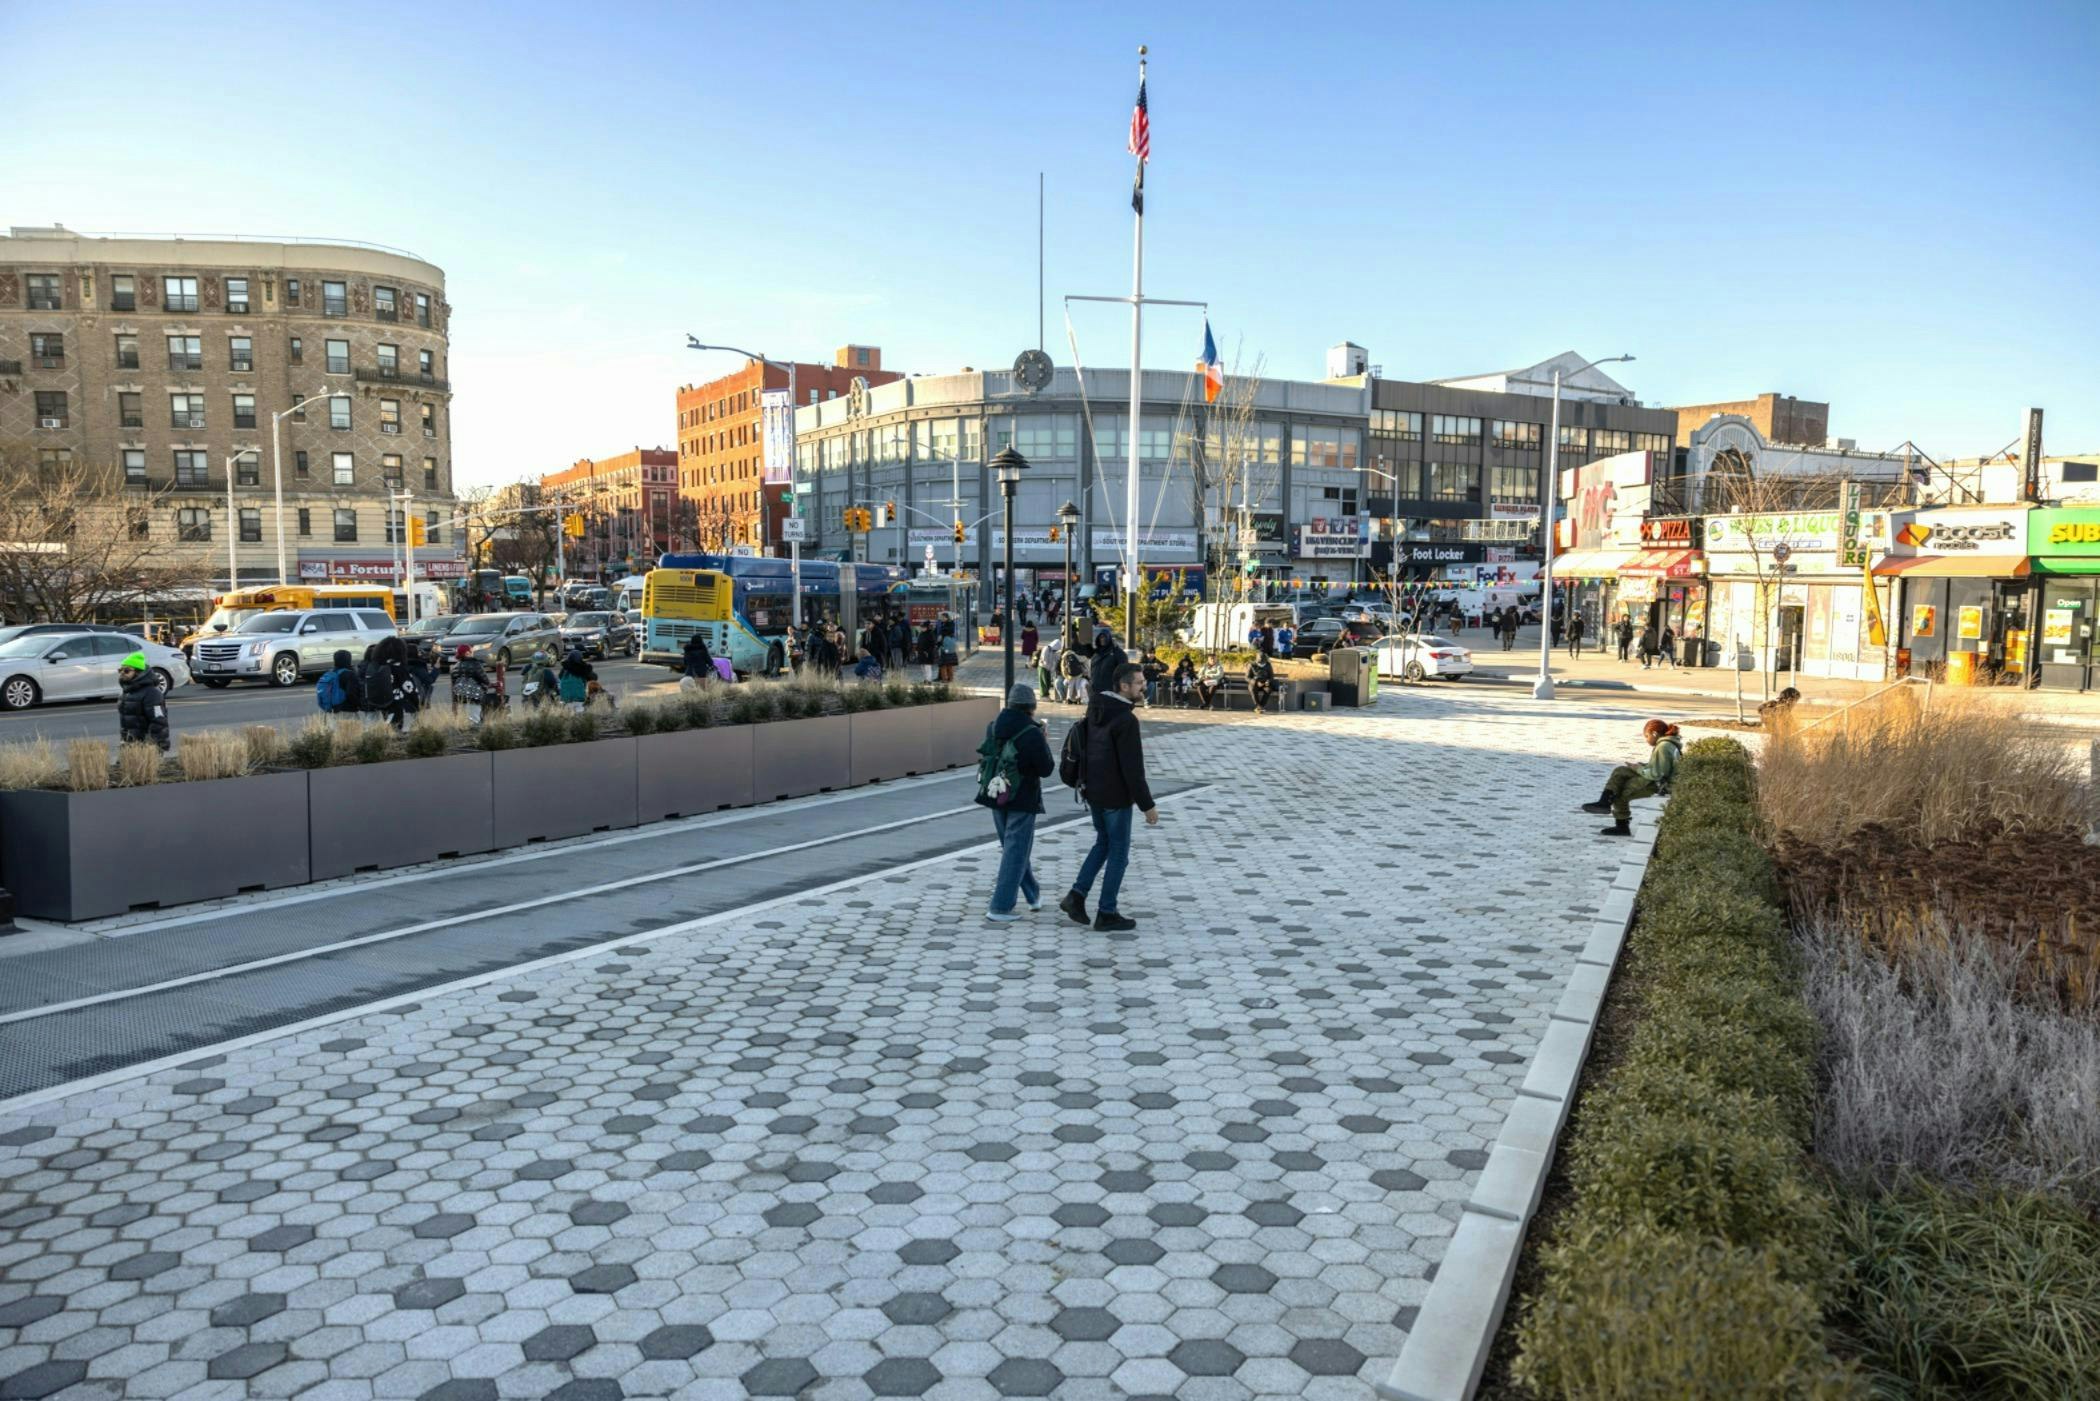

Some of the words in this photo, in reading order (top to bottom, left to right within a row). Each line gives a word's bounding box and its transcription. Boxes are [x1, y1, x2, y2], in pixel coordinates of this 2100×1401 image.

[1661, 520, 1690, 539] PIZZA
[1792, 515, 1840, 534] LIQUO
[1844, 485, 1867, 564] LIQUORS
[1933, 521, 2016, 540] boost
[1412, 548, 1433, 560] Foot
[1434, 548, 1465, 560] Locker
[1933, 540, 1980, 550] mobile
[328, 563, 346, 574] La
[1476, 565, 1517, 583] FedEx
[2056, 599, 2081, 608] Open
